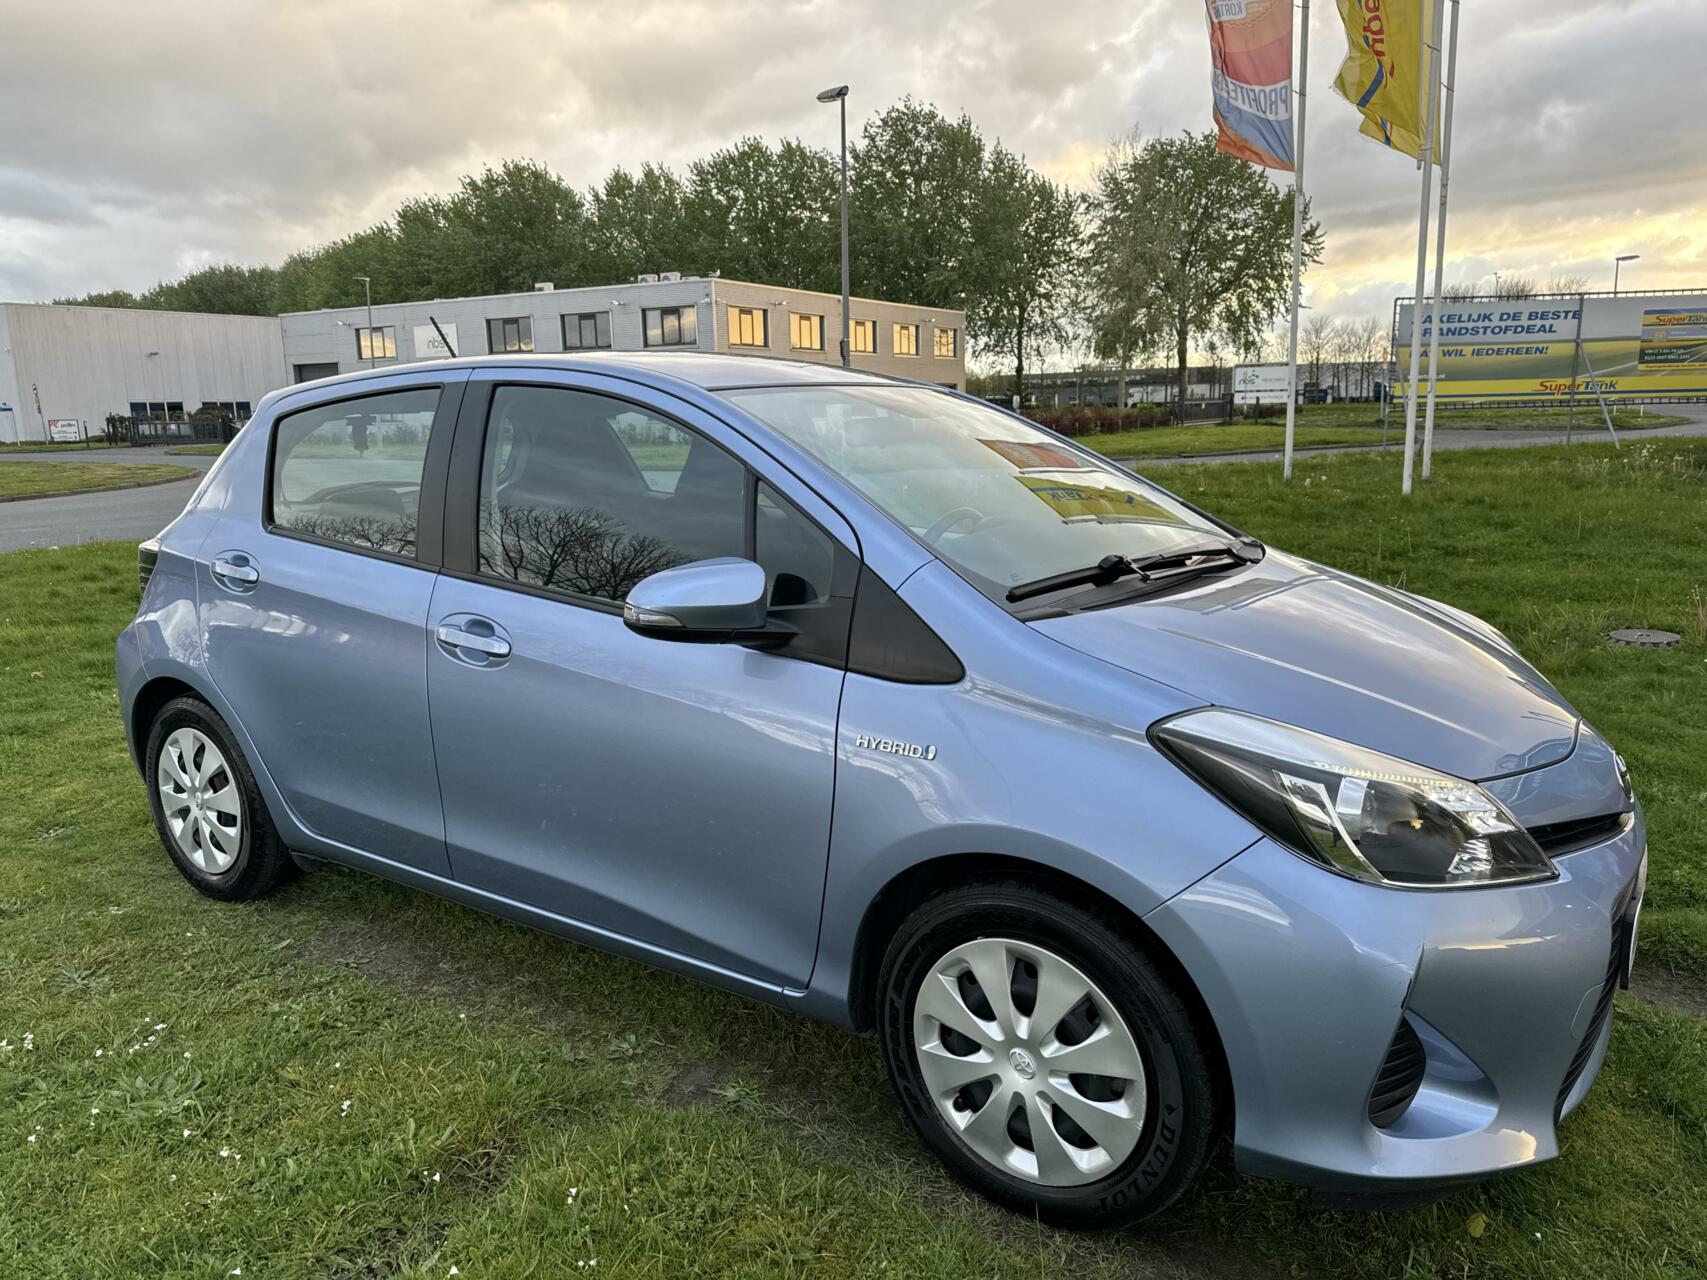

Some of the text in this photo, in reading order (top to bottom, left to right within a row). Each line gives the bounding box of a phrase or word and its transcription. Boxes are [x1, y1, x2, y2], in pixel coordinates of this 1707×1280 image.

[1411, 310, 1583, 325] AKELIJK DE BESTE
[1411, 324, 1557, 337] RANDSTOFDEAL
[1442, 348, 1466, 357] WIL
[1472, 346, 1549, 357] IEDEREEN!
[1537, 380, 1618, 395] SuperTank
[856, 734, 923, 758] HYBRID
